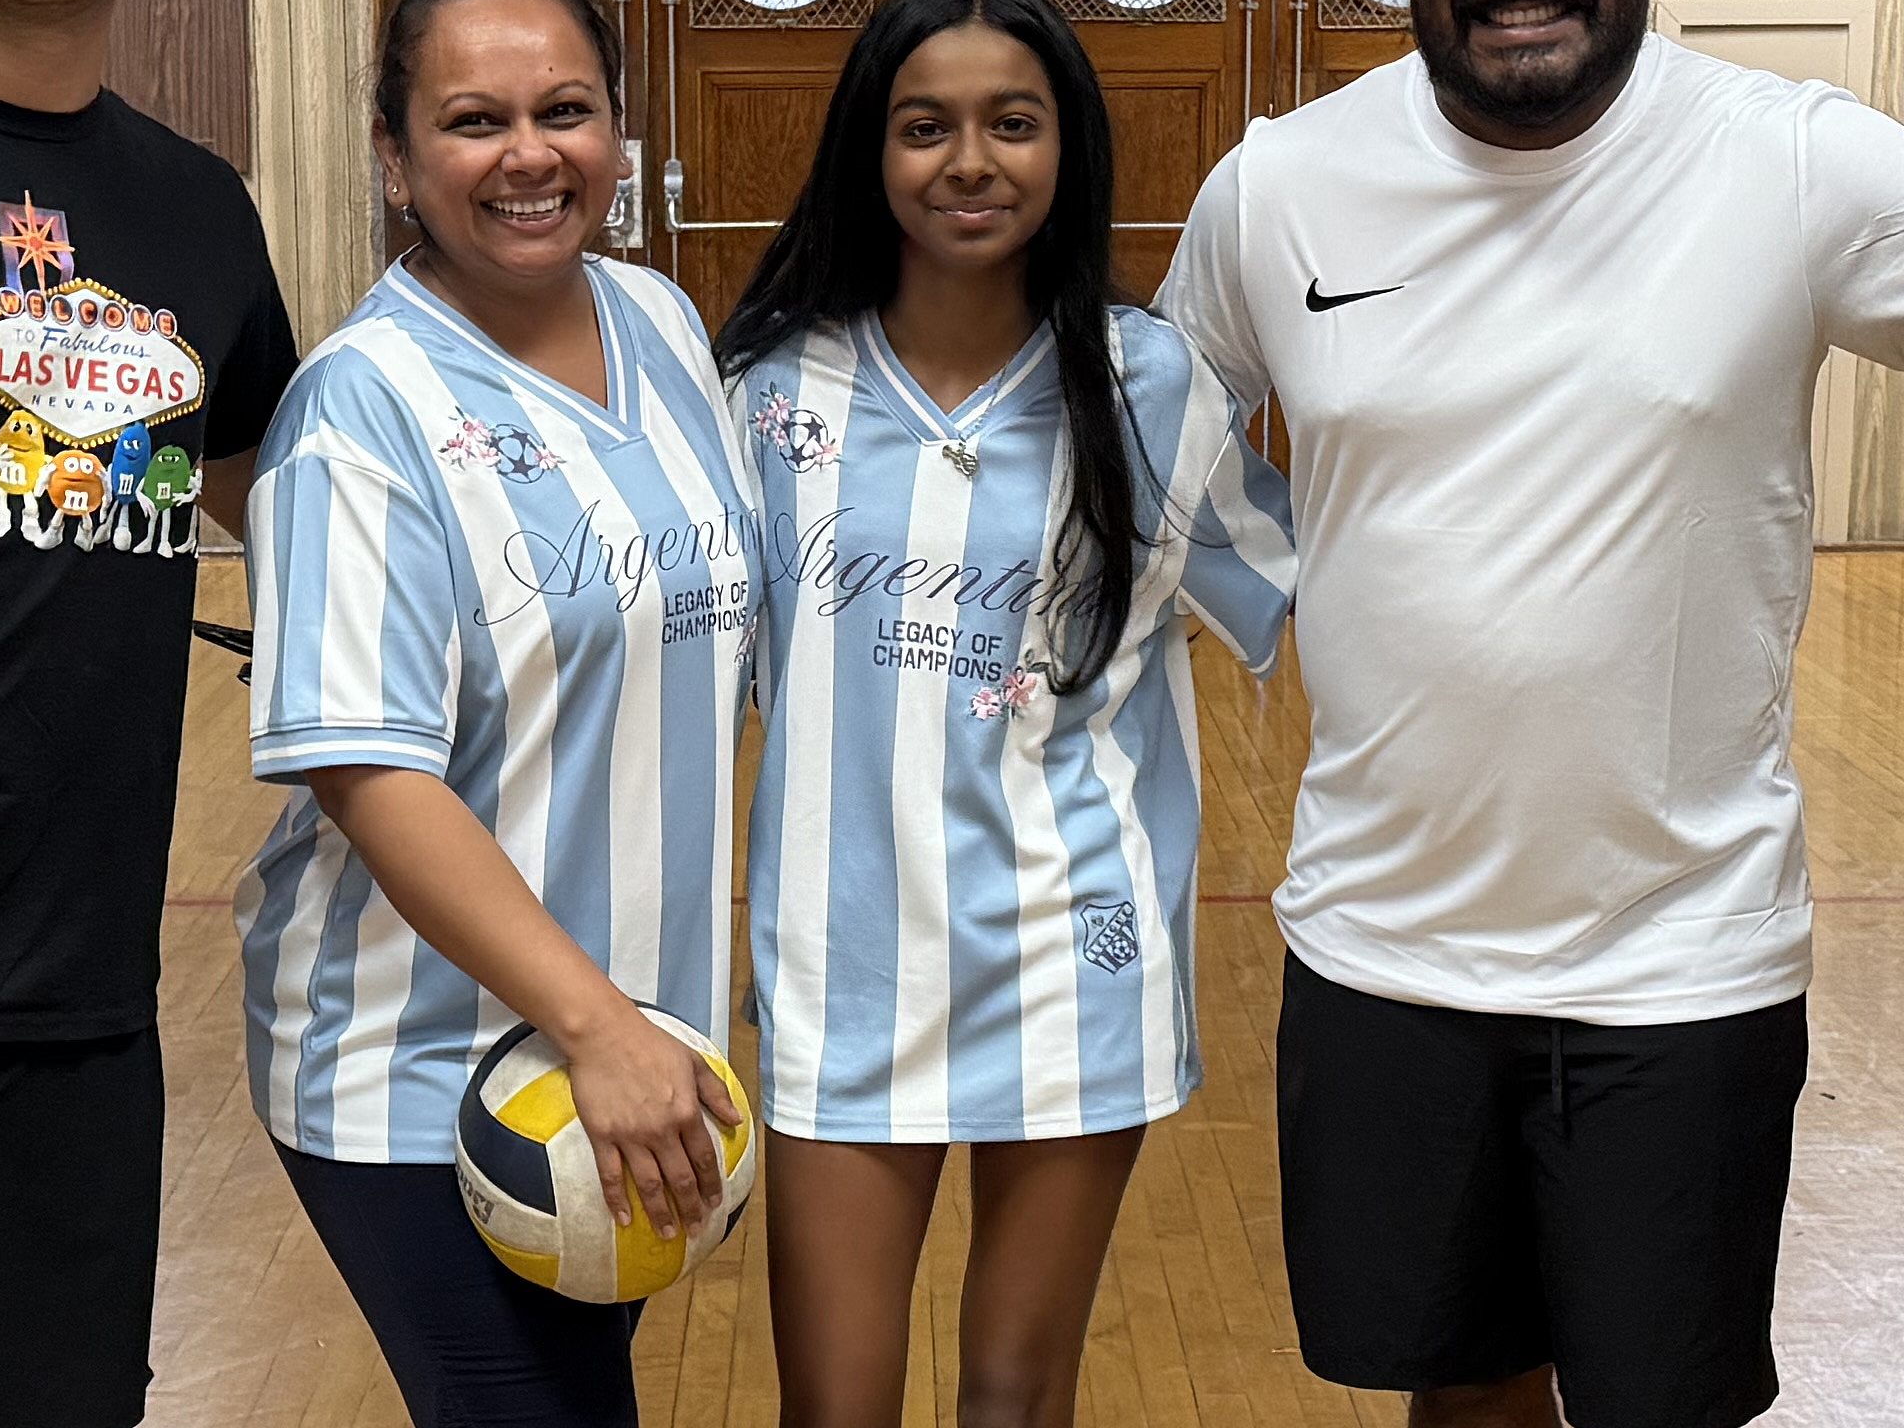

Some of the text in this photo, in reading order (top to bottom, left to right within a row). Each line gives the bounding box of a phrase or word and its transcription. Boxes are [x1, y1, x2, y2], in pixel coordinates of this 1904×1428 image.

[14, 325, 152, 359] TO Fabulous
[63, 355, 185, 403] VEGAS
[31, 394, 134, 416] NEVADA
[473, 500, 764, 626] Argentin
[664, 580, 748, 618] LEGACY OF
[662, 606, 748, 644] CHAMPIONS
[878, 618, 1003, 656] LEGACY OF
[873, 644, 1003, 682] CHAMPIONS
